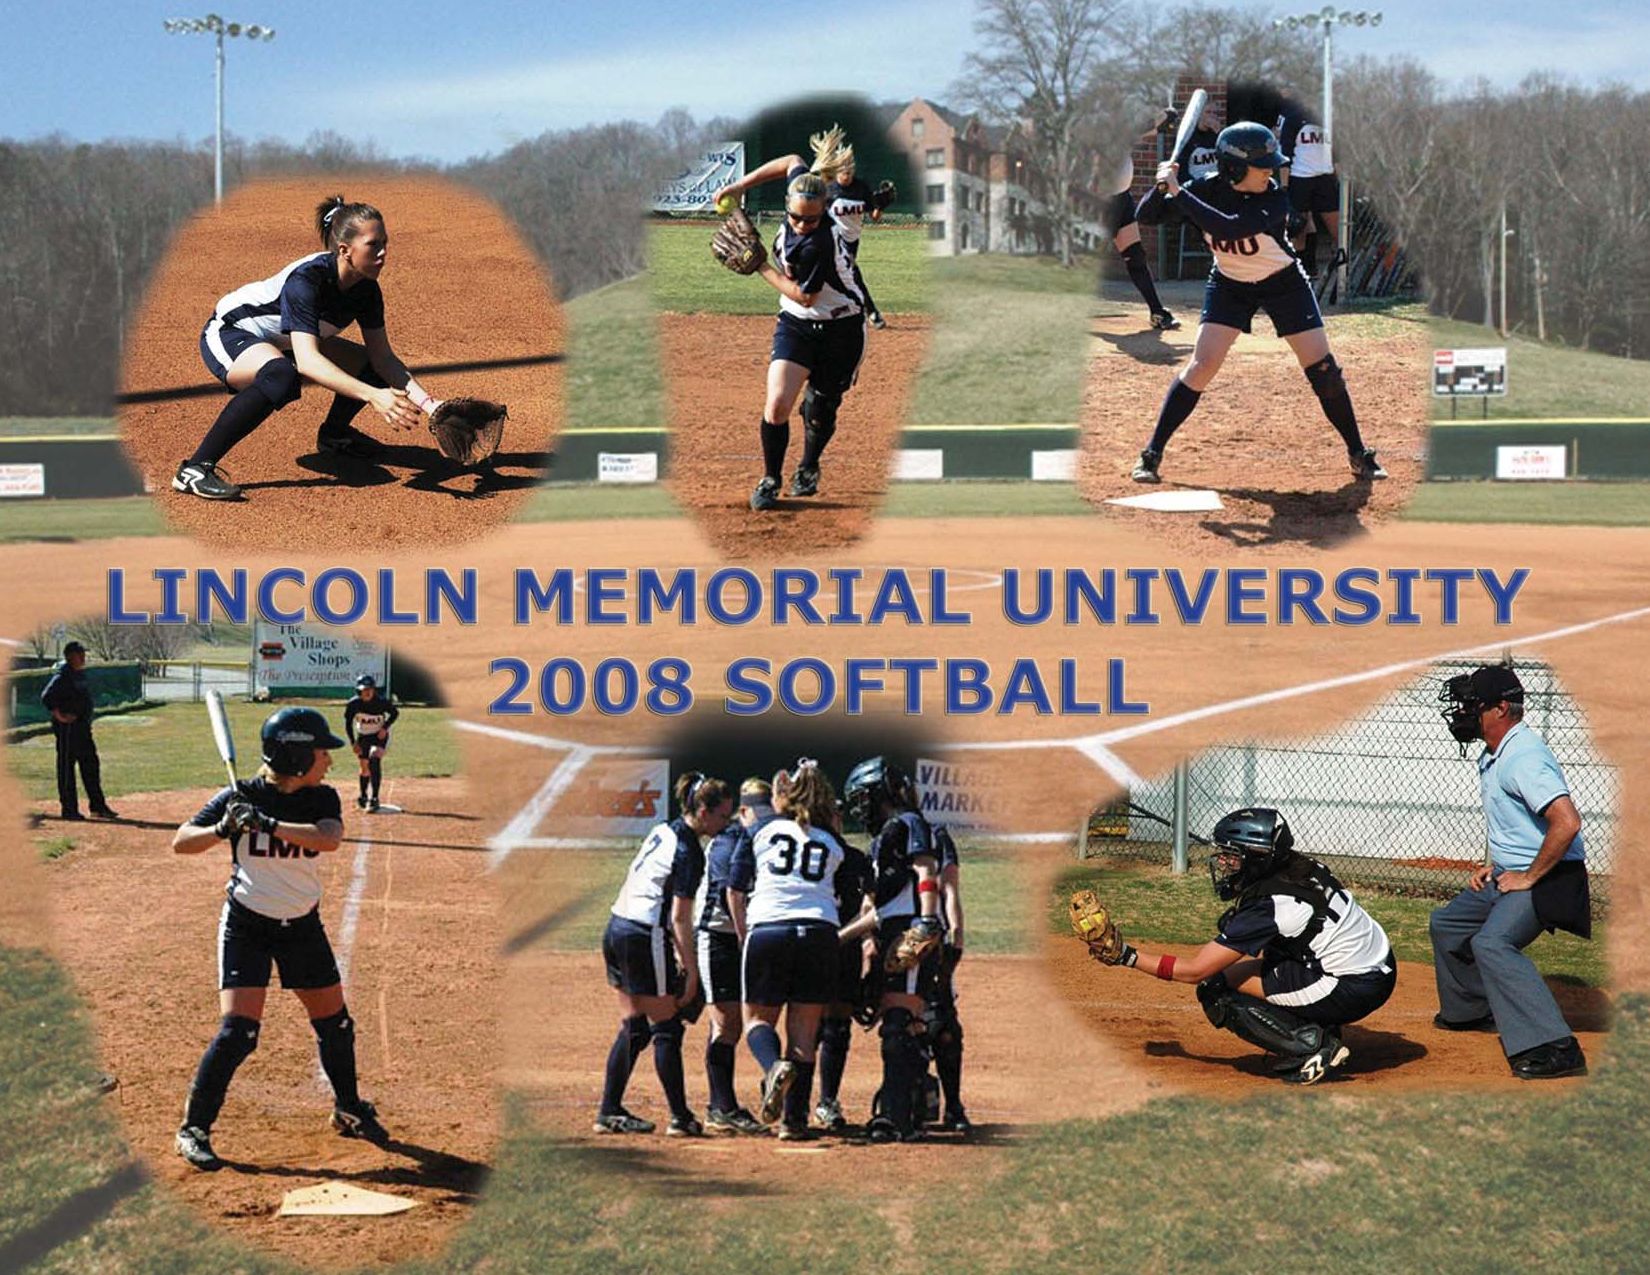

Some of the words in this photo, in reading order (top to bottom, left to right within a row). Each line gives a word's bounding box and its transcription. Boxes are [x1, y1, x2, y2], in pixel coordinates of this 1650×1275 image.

[280, 625, 302, 635] The
[290, 636, 339, 651] Village
[308, 652, 351, 667] Shops
[768, 833, 829, 882] 30
